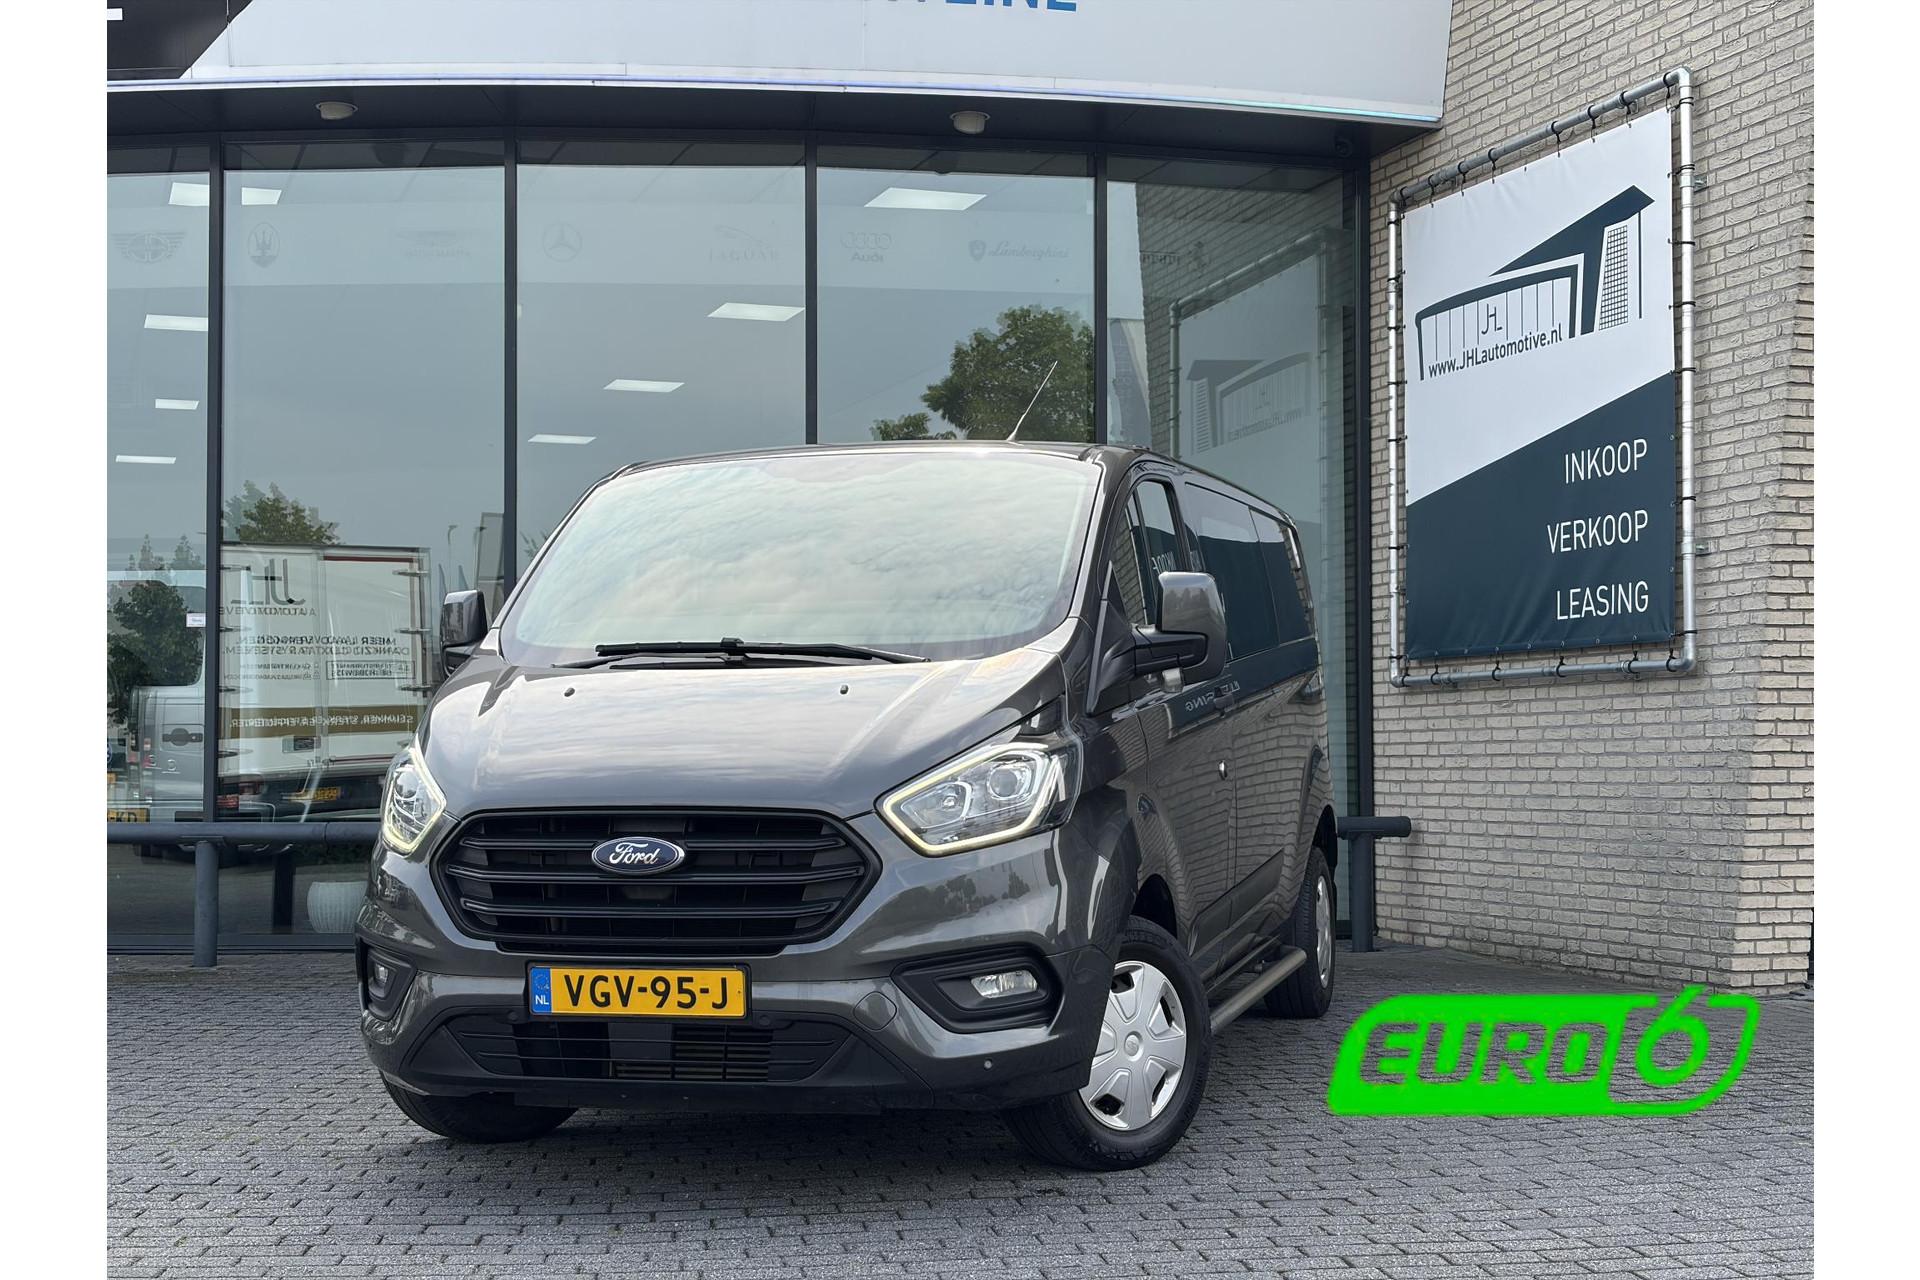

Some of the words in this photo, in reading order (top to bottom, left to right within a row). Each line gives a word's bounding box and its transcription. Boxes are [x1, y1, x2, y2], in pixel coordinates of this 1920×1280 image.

[850, 252, 883, 263] Audi
[987, 240, 1069, 260] Lamborghini
[1481, 303, 1503, 335] JHL
[1428, 322, 1563, 379] www.JHLautomotive.nl
[1565, 438, 1648, 484] INKOOP
[1547, 509, 1649, 554] VERKOOP
[1556, 580, 1649, 621] LEASING
[608, 841, 661, 865] Ford
[535, 994, 550, 1006] NL
[563, 974, 728, 1010] VGV-95-J
